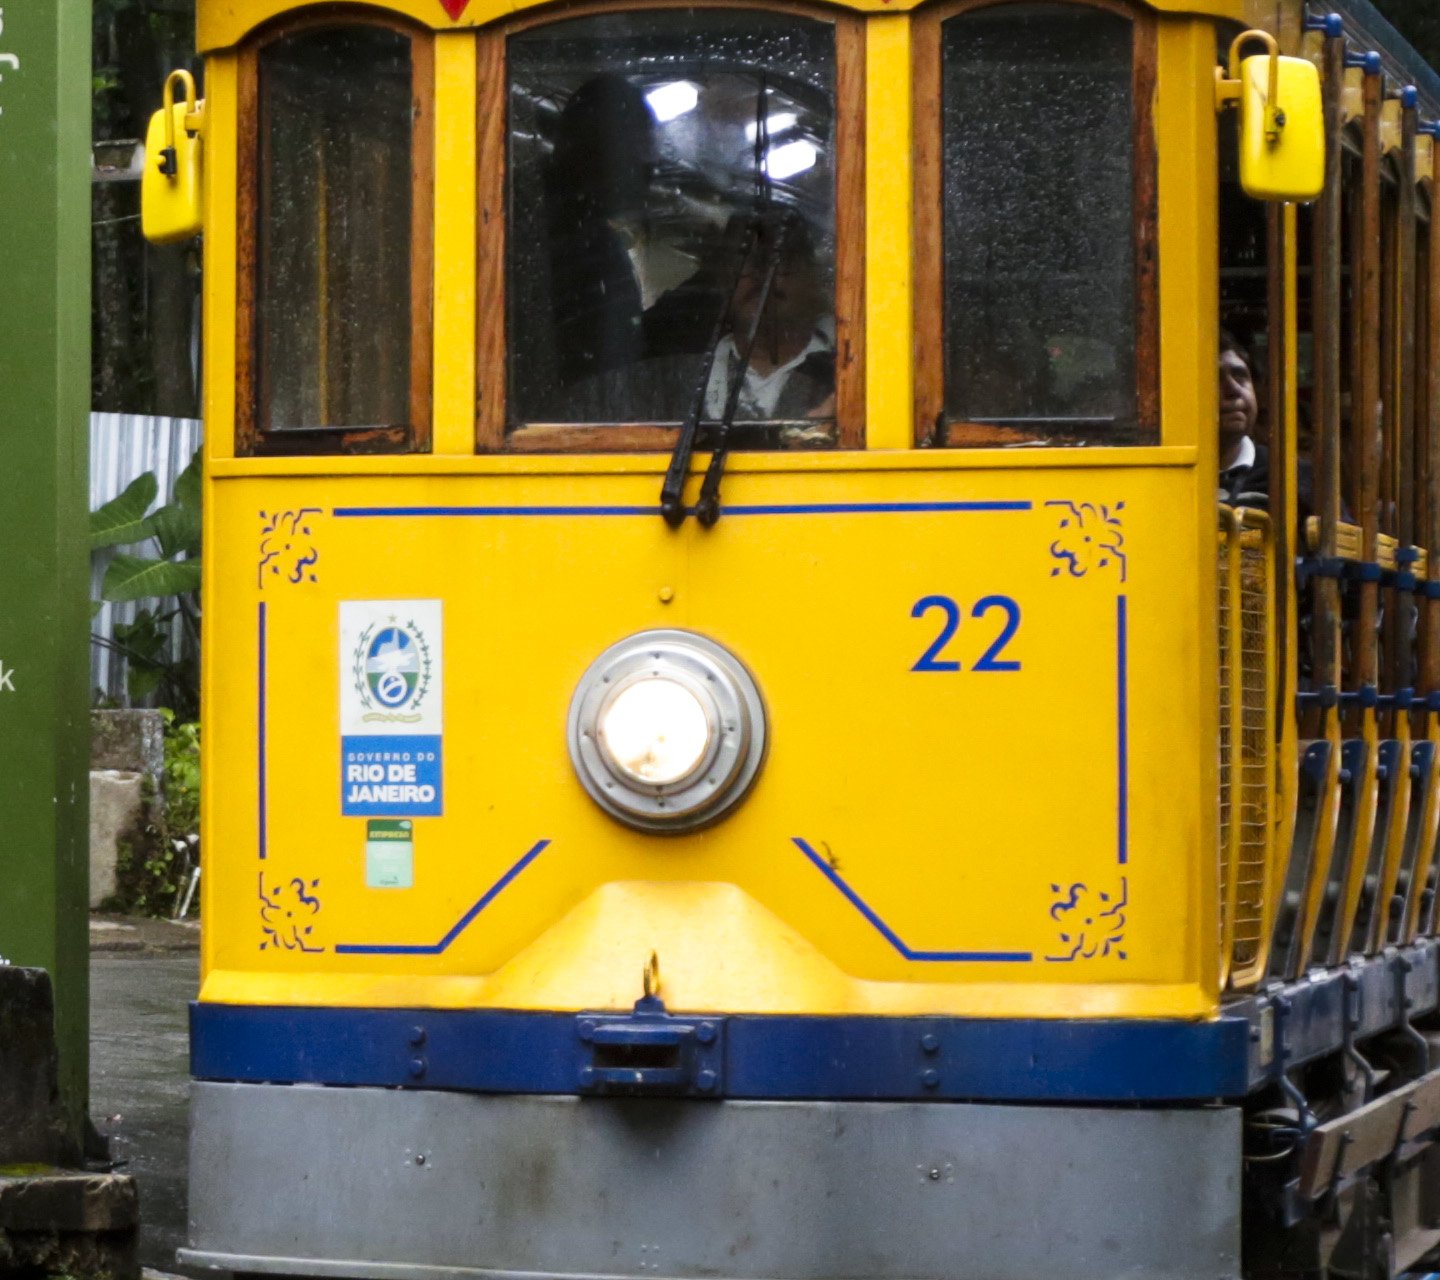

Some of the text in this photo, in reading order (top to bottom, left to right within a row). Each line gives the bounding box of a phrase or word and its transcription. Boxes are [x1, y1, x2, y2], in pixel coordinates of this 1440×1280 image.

[909, 594, 1022, 672] 22
[347, 752, 435, 762] GOVERNO DO
[347, 764, 416, 783] RIO DE
[347, 785, 436, 803] JANEIRO
